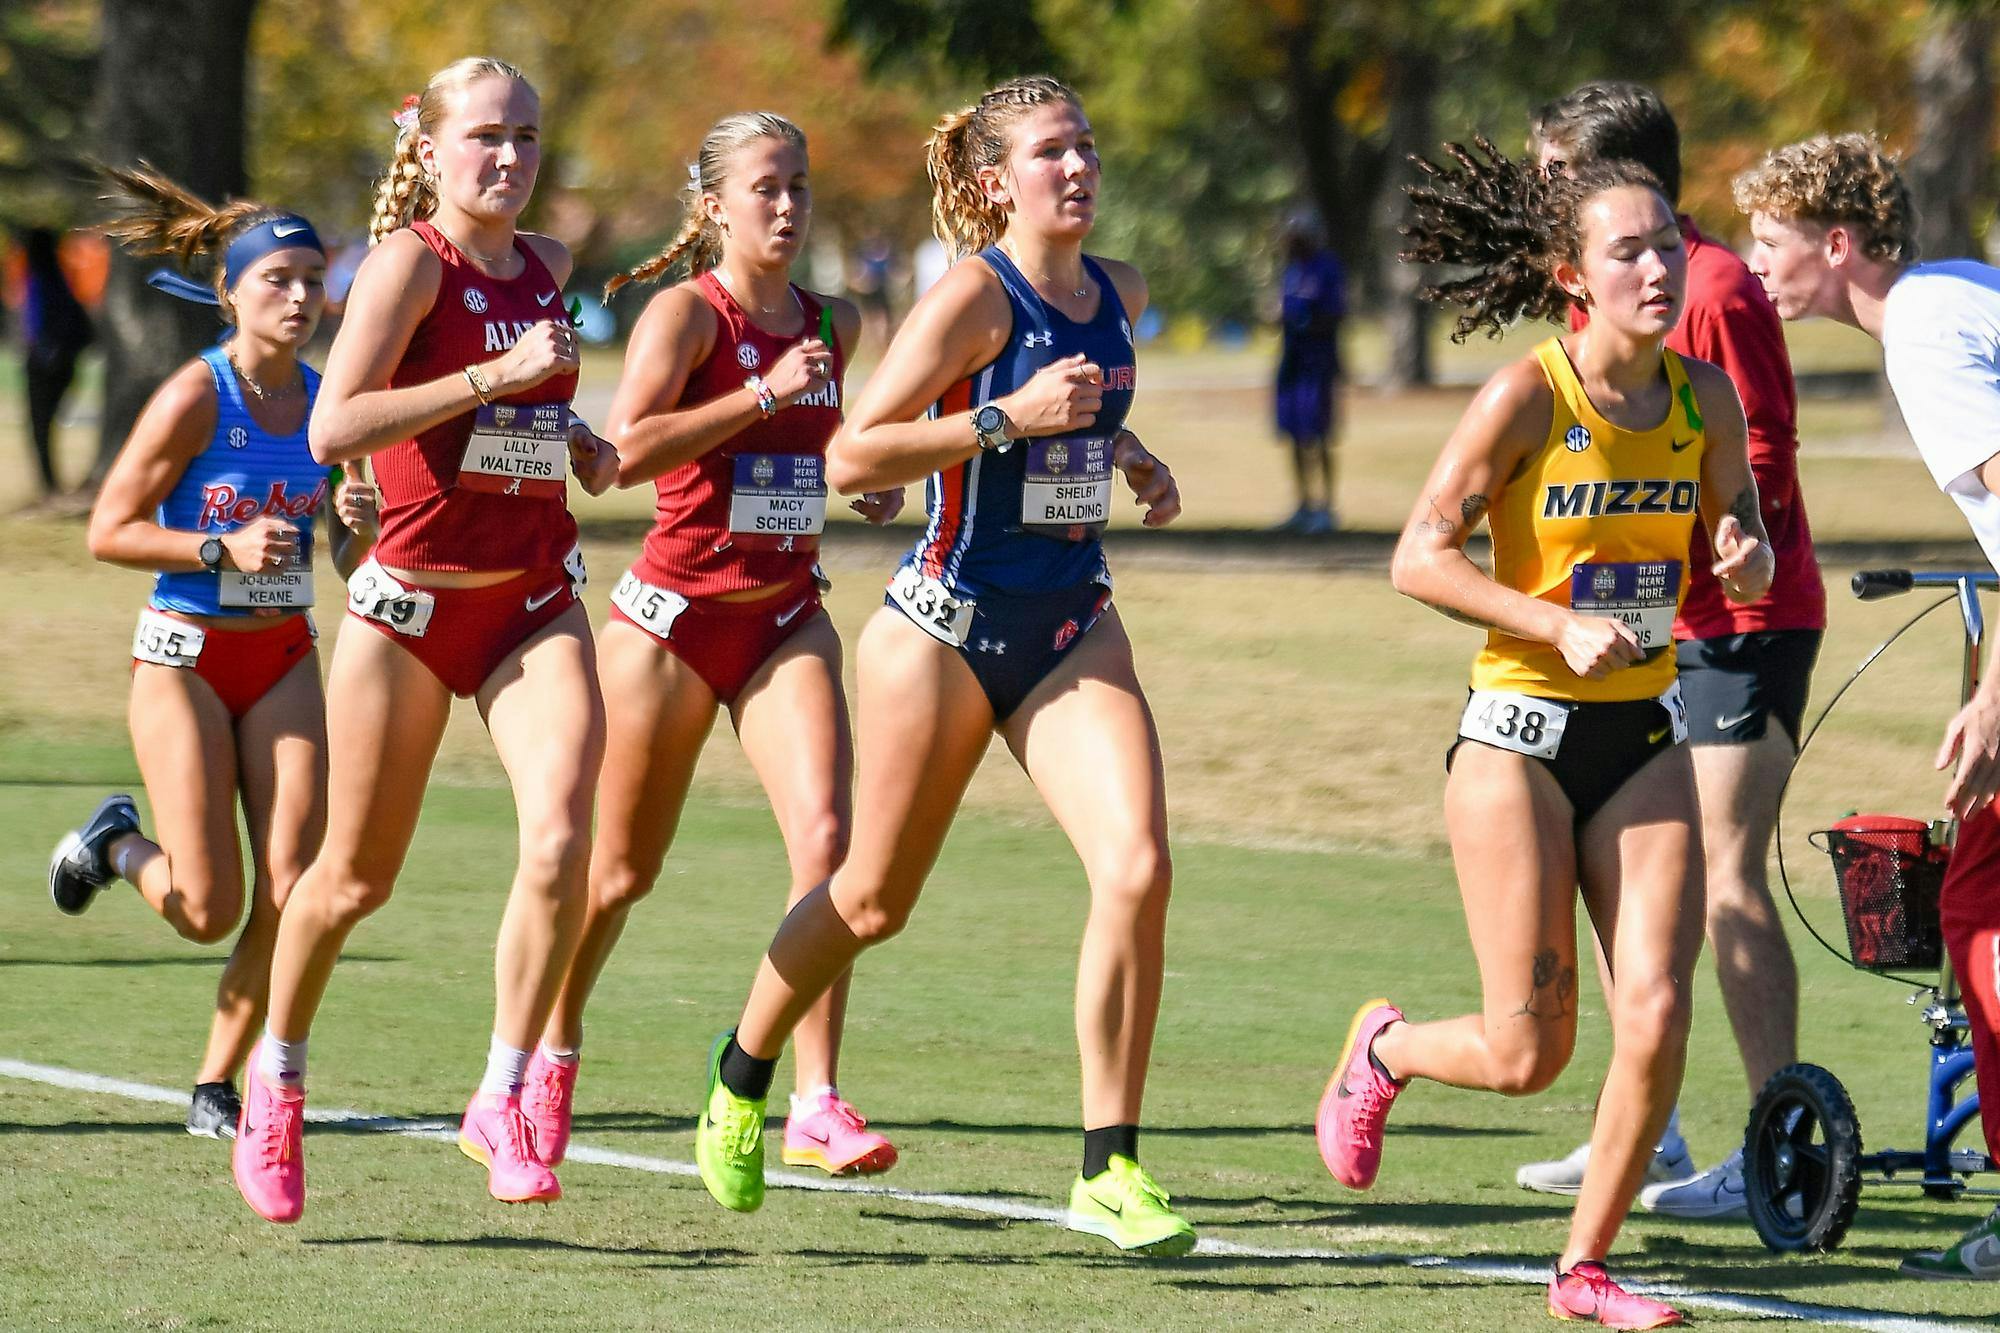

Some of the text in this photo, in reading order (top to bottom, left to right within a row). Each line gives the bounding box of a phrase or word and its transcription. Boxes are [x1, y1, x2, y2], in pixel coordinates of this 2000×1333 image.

[464, 289, 487, 312] SEC
[739, 346, 759, 367] SEC
[534, 409, 559, 420] MEANS
[532, 420, 559, 432] MORE
[229, 427, 247, 448] SEC
[1566, 426, 1590, 452] SEC
[503, 440, 540, 455] LILLY
[480, 455, 553, 476] WALTERS
[1086, 461, 1105, 474] MORE
[794, 468, 818, 477] MEANS
[794, 479, 818, 489] MORE
[1055, 485, 1098, 499] SHELBY
[769, 499, 805, 511] MACY
[1045, 503, 1102, 520] BALDING
[755, 516, 812, 531] SCHELP
[1647, 565, 1667, 575] JUST
[239, 574, 302, 586] JO-LAUREN
[1638, 576, 1665, 587] MEANS
[249, 591, 293, 603] KEANE
[1636, 588, 1664, 600] MORE
[1478, 700, 1548, 746] 438
